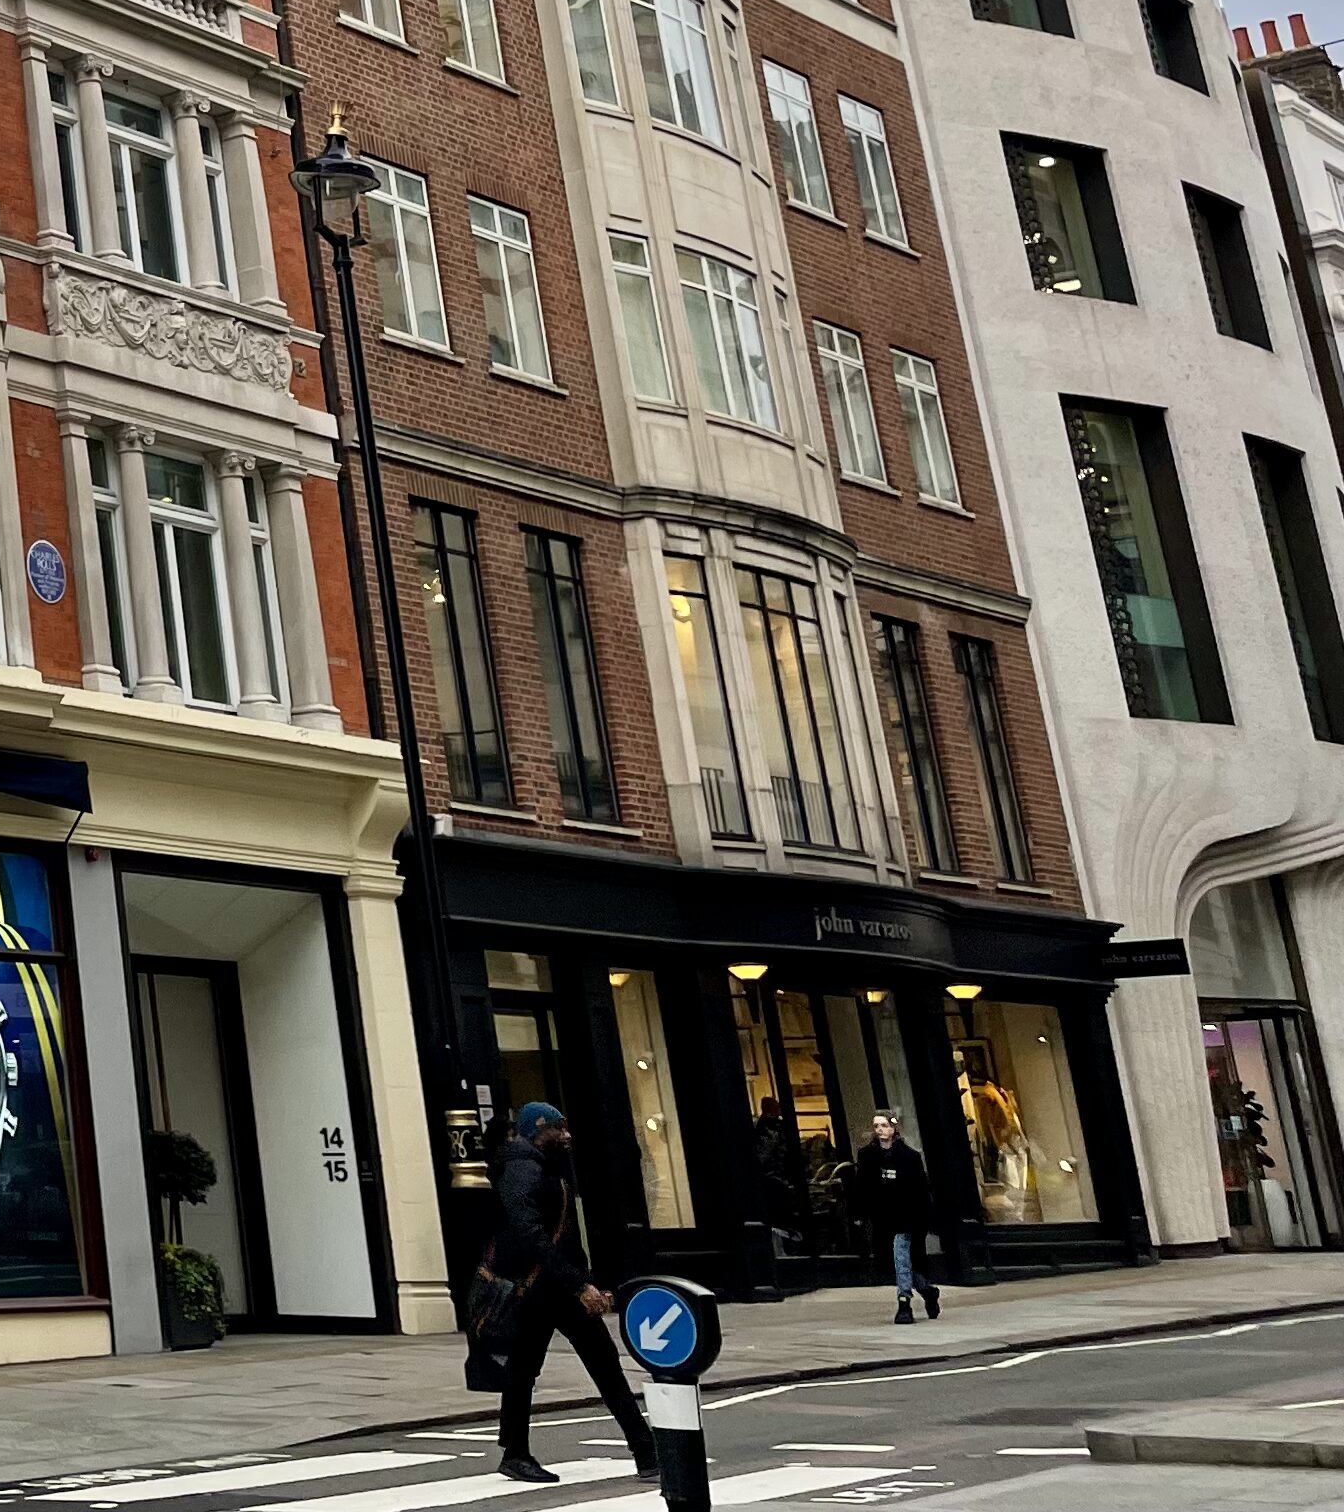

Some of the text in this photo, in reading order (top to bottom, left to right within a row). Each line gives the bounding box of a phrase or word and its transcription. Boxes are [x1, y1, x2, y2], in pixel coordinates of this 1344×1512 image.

[814, 906, 854, 941] john
[320, 1127, 344, 1149] 14
[323, 1160, 348, 1182] 15
